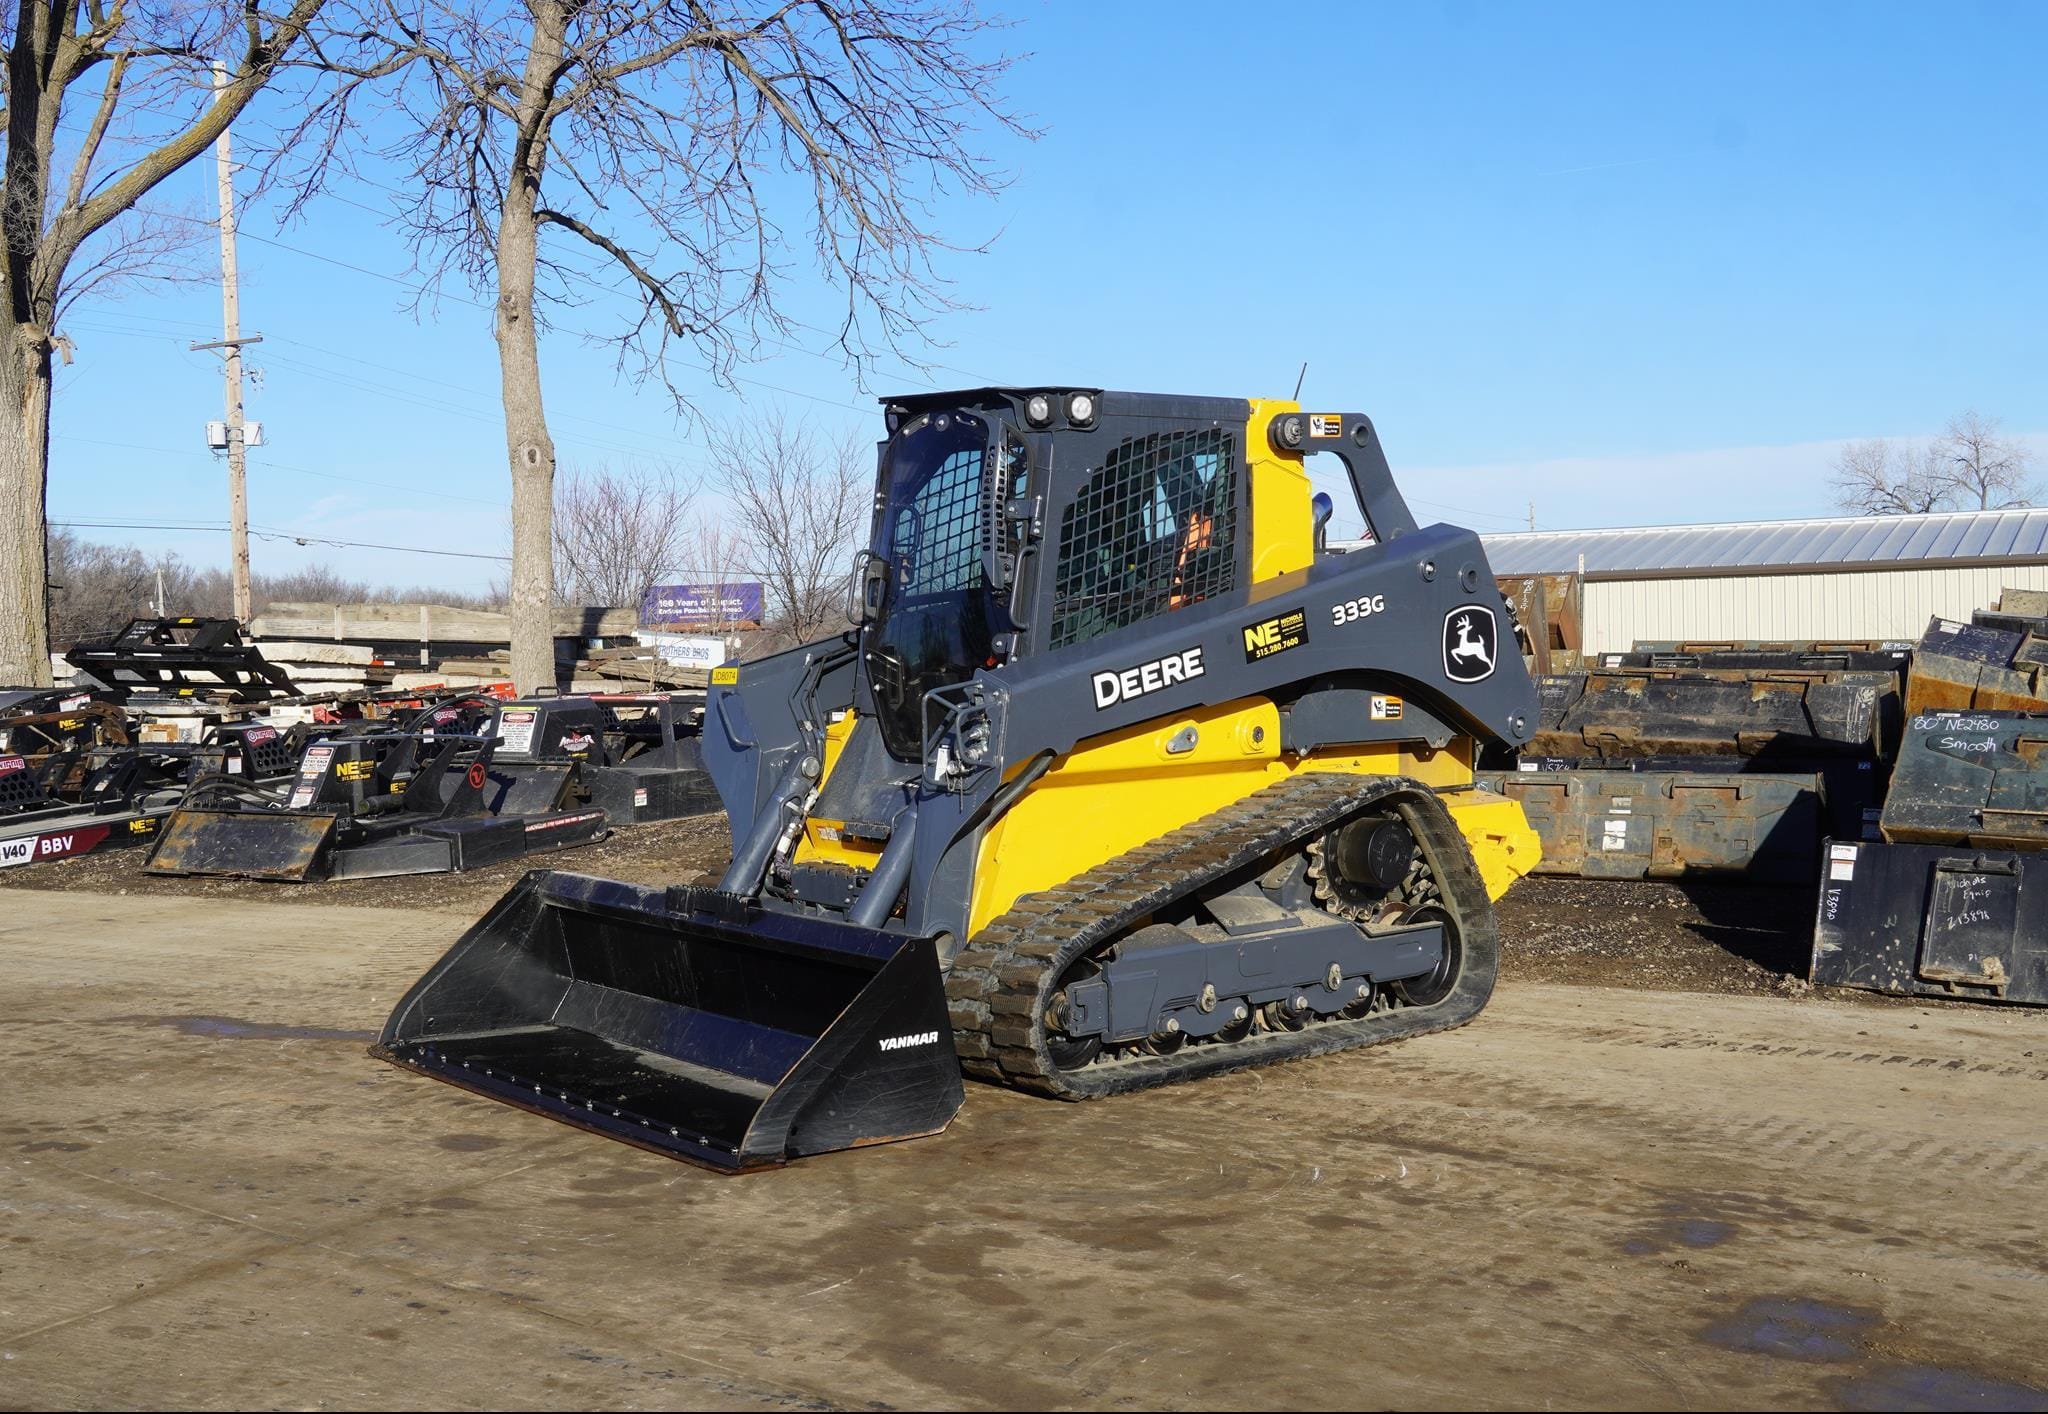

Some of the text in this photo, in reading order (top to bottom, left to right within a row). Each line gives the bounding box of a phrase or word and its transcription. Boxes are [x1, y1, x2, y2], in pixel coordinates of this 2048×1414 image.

[676, 599, 698, 607] Years
[1332, 594, 1385, 626] 333G
[1244, 619, 1281, 652] NE
[657, 644, 691, 657] TRUTHERS
[1256, 637, 1299, 658] 515.280.7600
[713, 671, 736, 681] JD8074
[1093, 647, 1205, 709] DEERE
[1945, 718, 2000, 731] NE2480
[1939, 736, 1996, 753] Smooth
[336, 761, 360, 777] NE
[129, 819, 146, 831] NE
[41, 835, 74, 855] BBV
[878, 1031, 939, 1052] YANMAR
